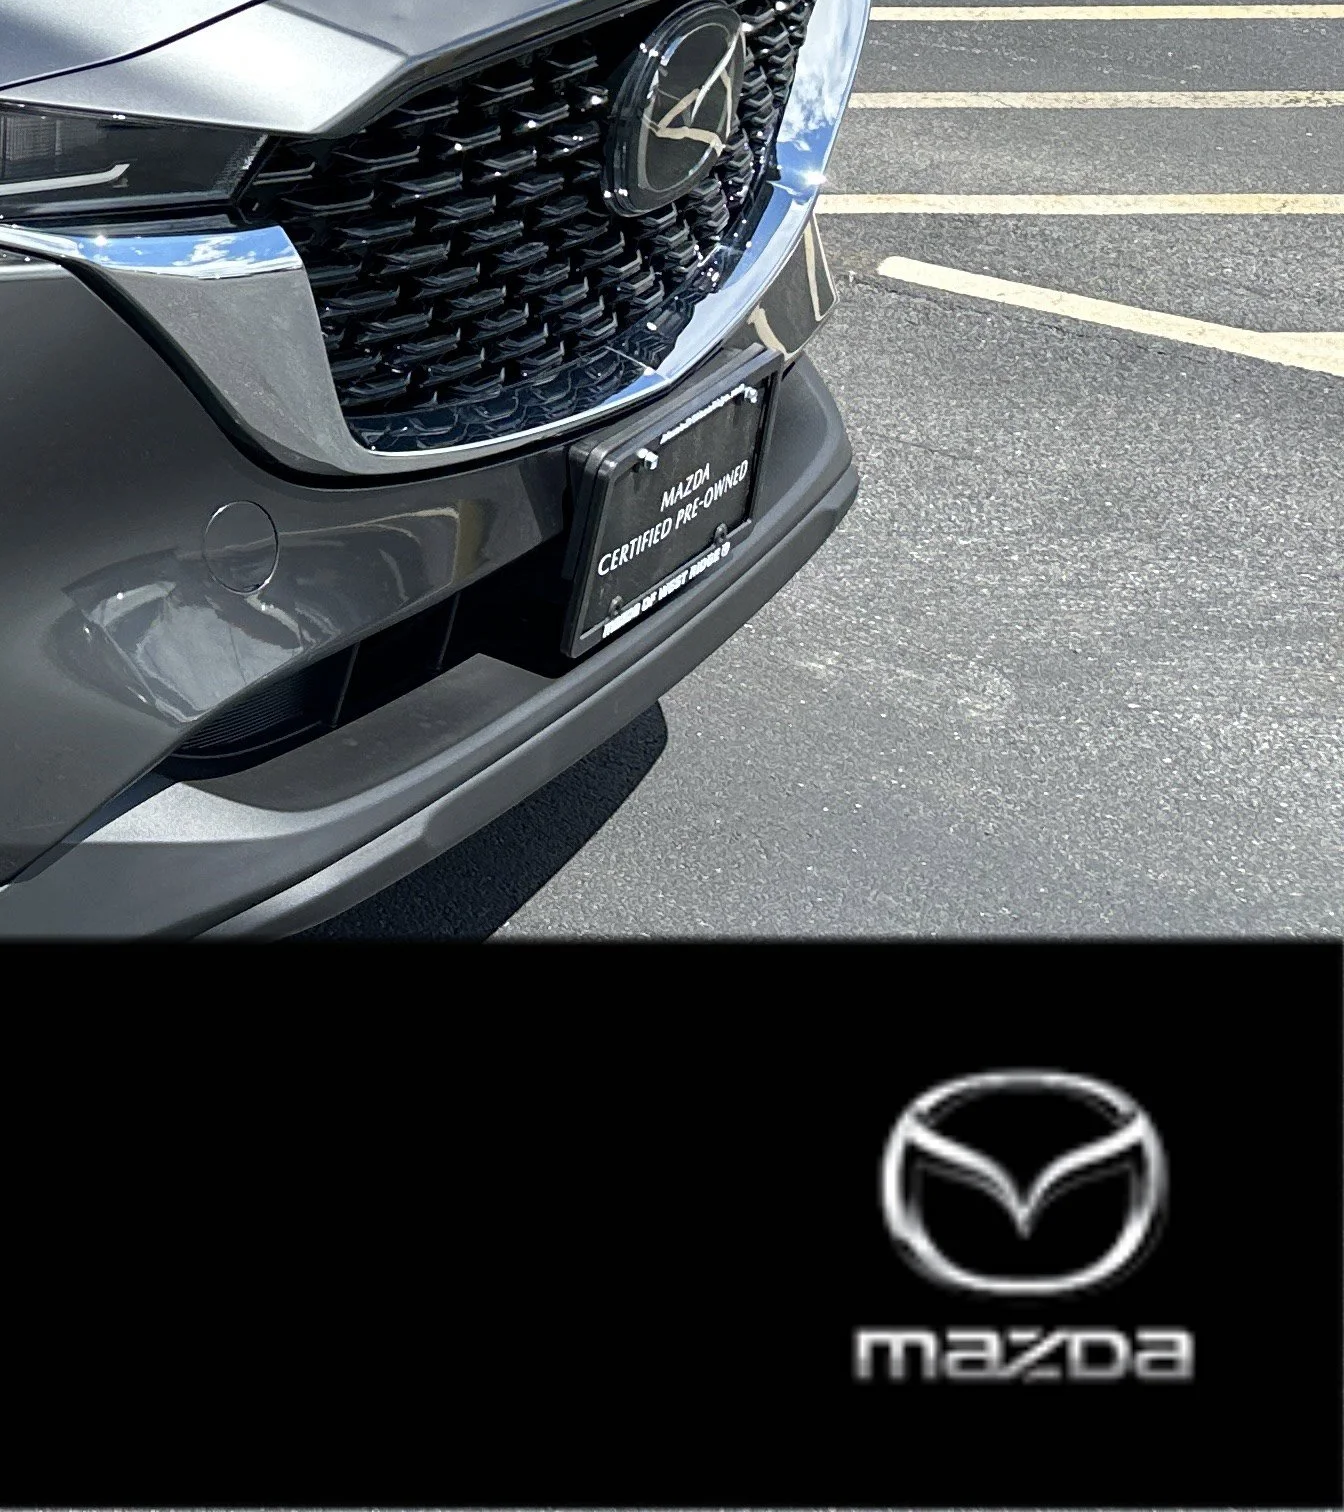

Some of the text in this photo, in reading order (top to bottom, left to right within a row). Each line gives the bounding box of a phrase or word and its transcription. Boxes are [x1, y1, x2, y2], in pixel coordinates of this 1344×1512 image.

[597, 459, 749, 576] CERTIFIED PRE-OWNED
[659, 462, 710, 512] MAZDA
